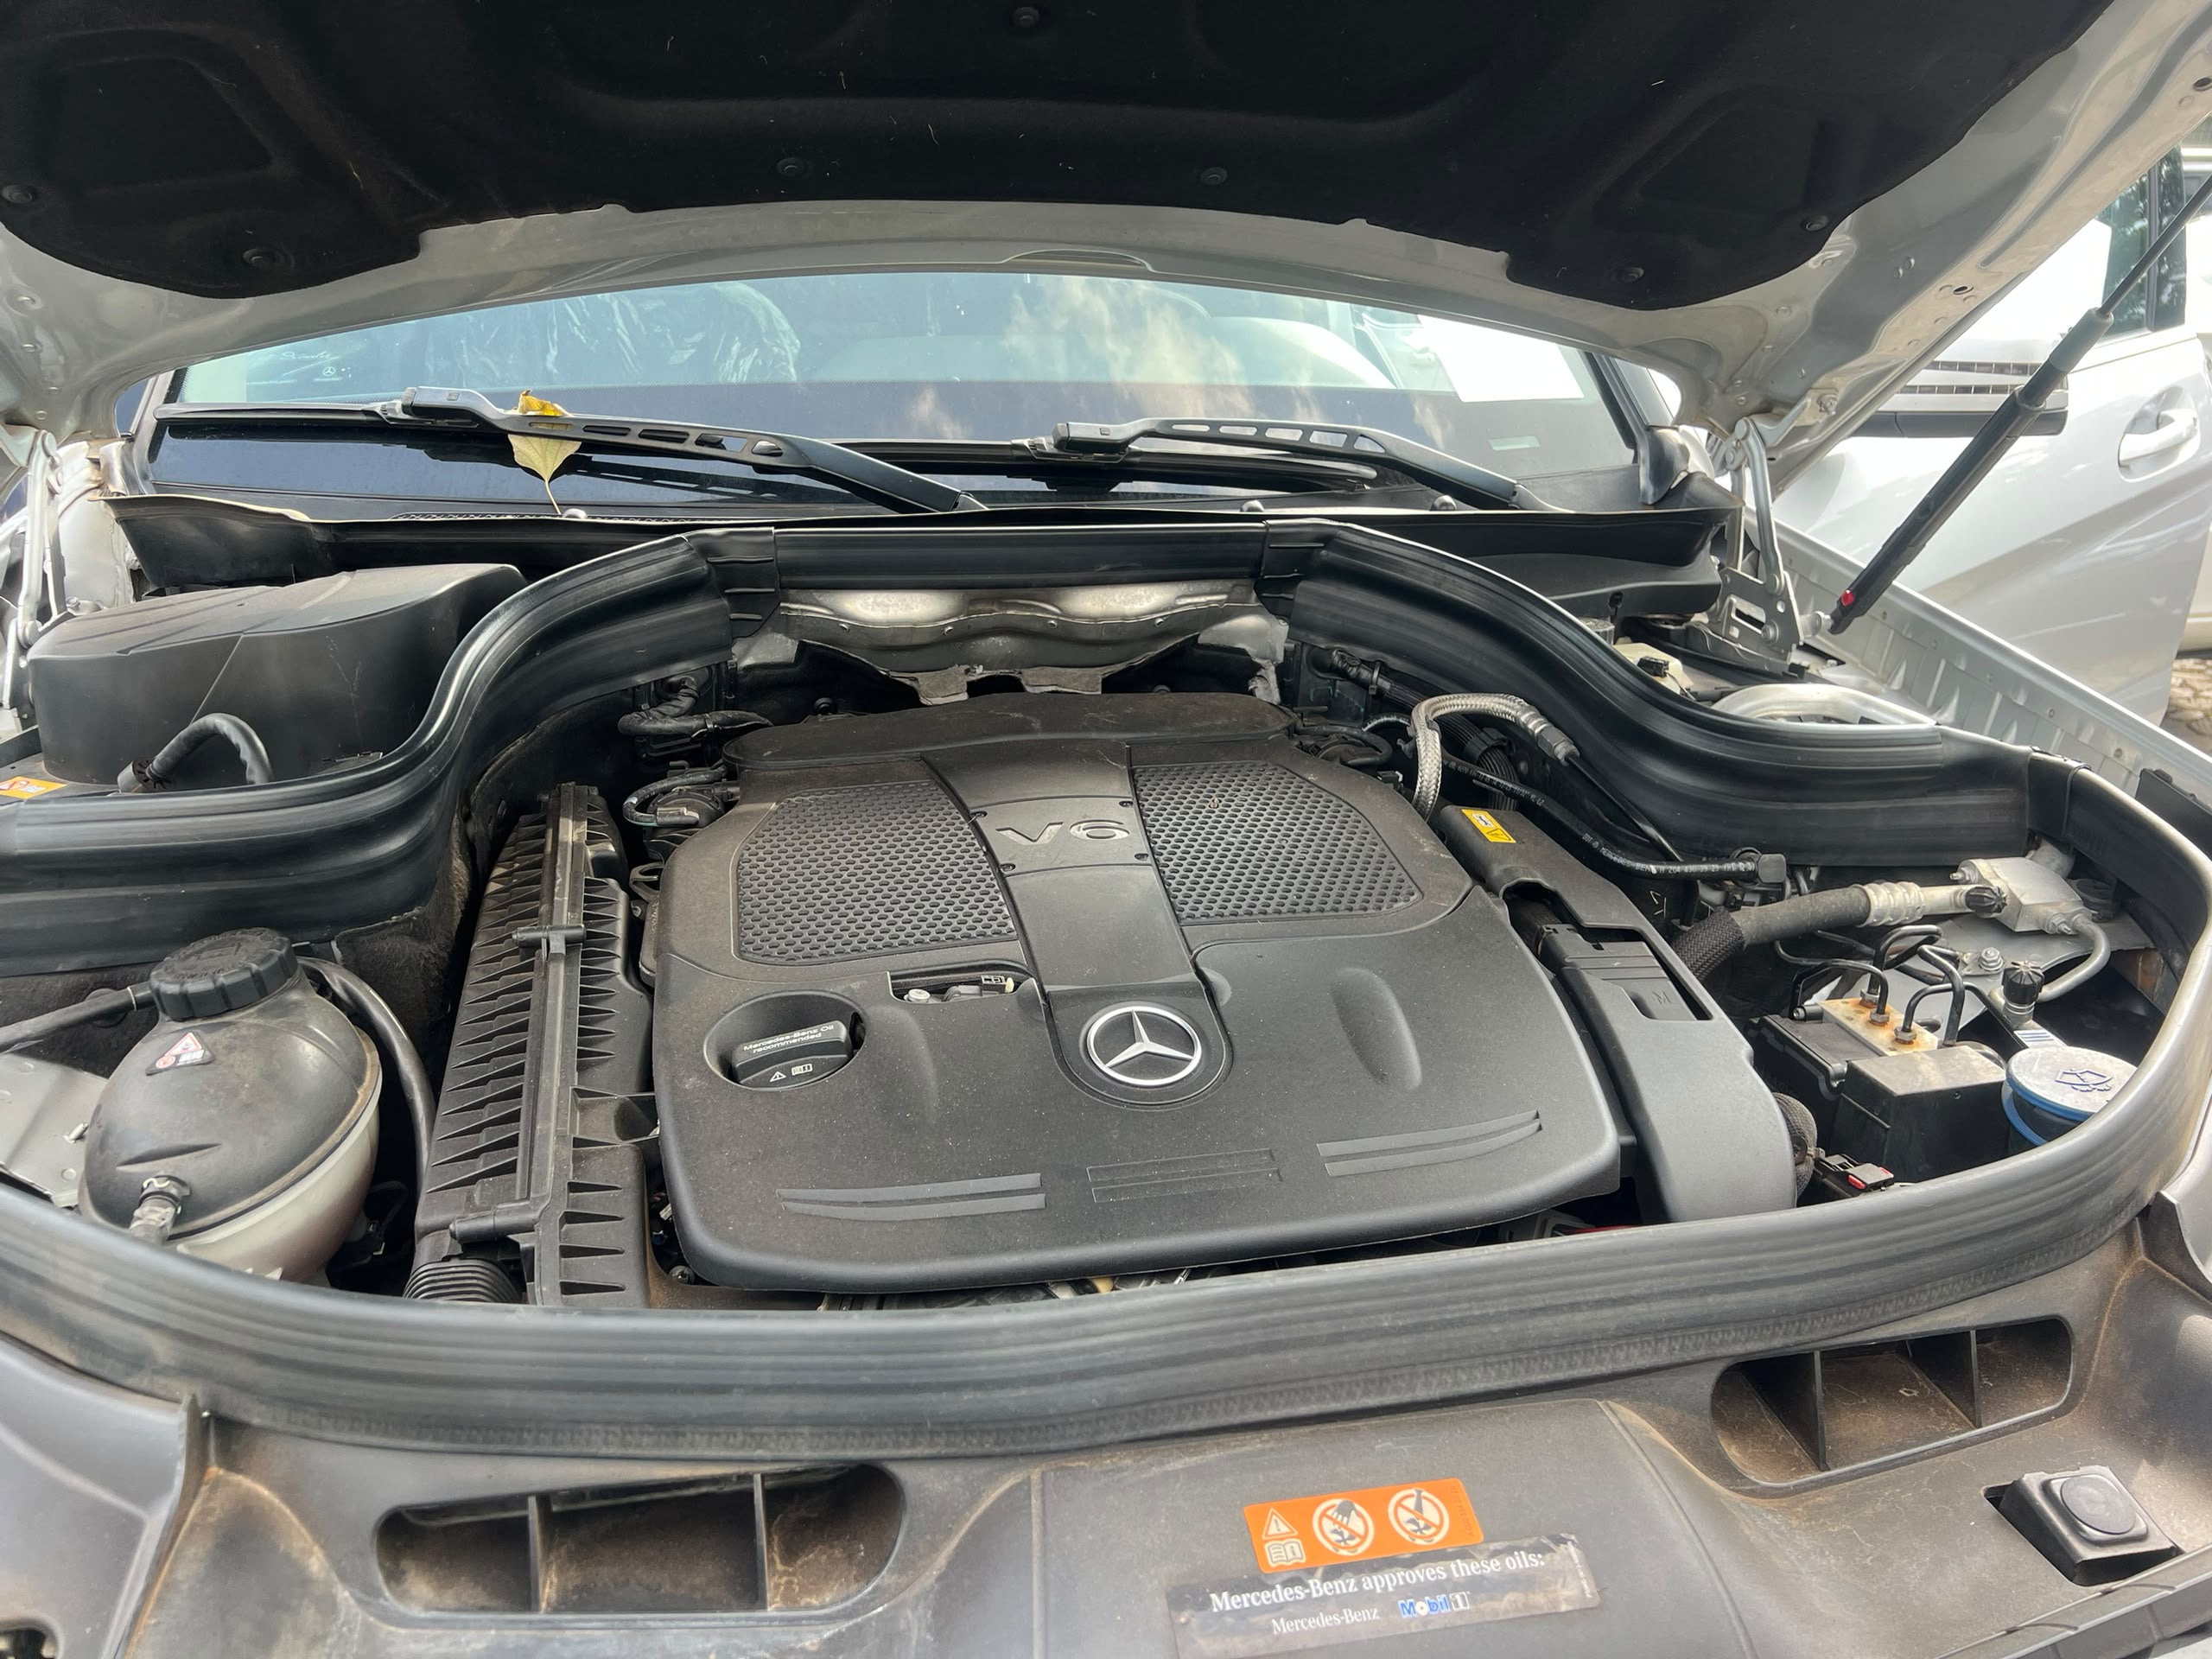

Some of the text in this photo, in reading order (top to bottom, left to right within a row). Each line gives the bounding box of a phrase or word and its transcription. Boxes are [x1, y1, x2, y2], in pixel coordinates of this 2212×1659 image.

[995, 818, 1130, 846] V6
[743, 1025, 834, 1051] Mercedes-Benz Oil
[753, 1033, 822, 1053] recommended
[1210, 1578, 1358, 1612] Mercedes-Benz
[1363, 1566, 1446, 1592] approves
[1450, 1558, 1501, 1576] these
[1505, 1550, 1545, 1571] oils:
[1271, 1607, 1380, 1635] Mercedes-Benz
[1398, 1596, 1451, 1618] Mobil
